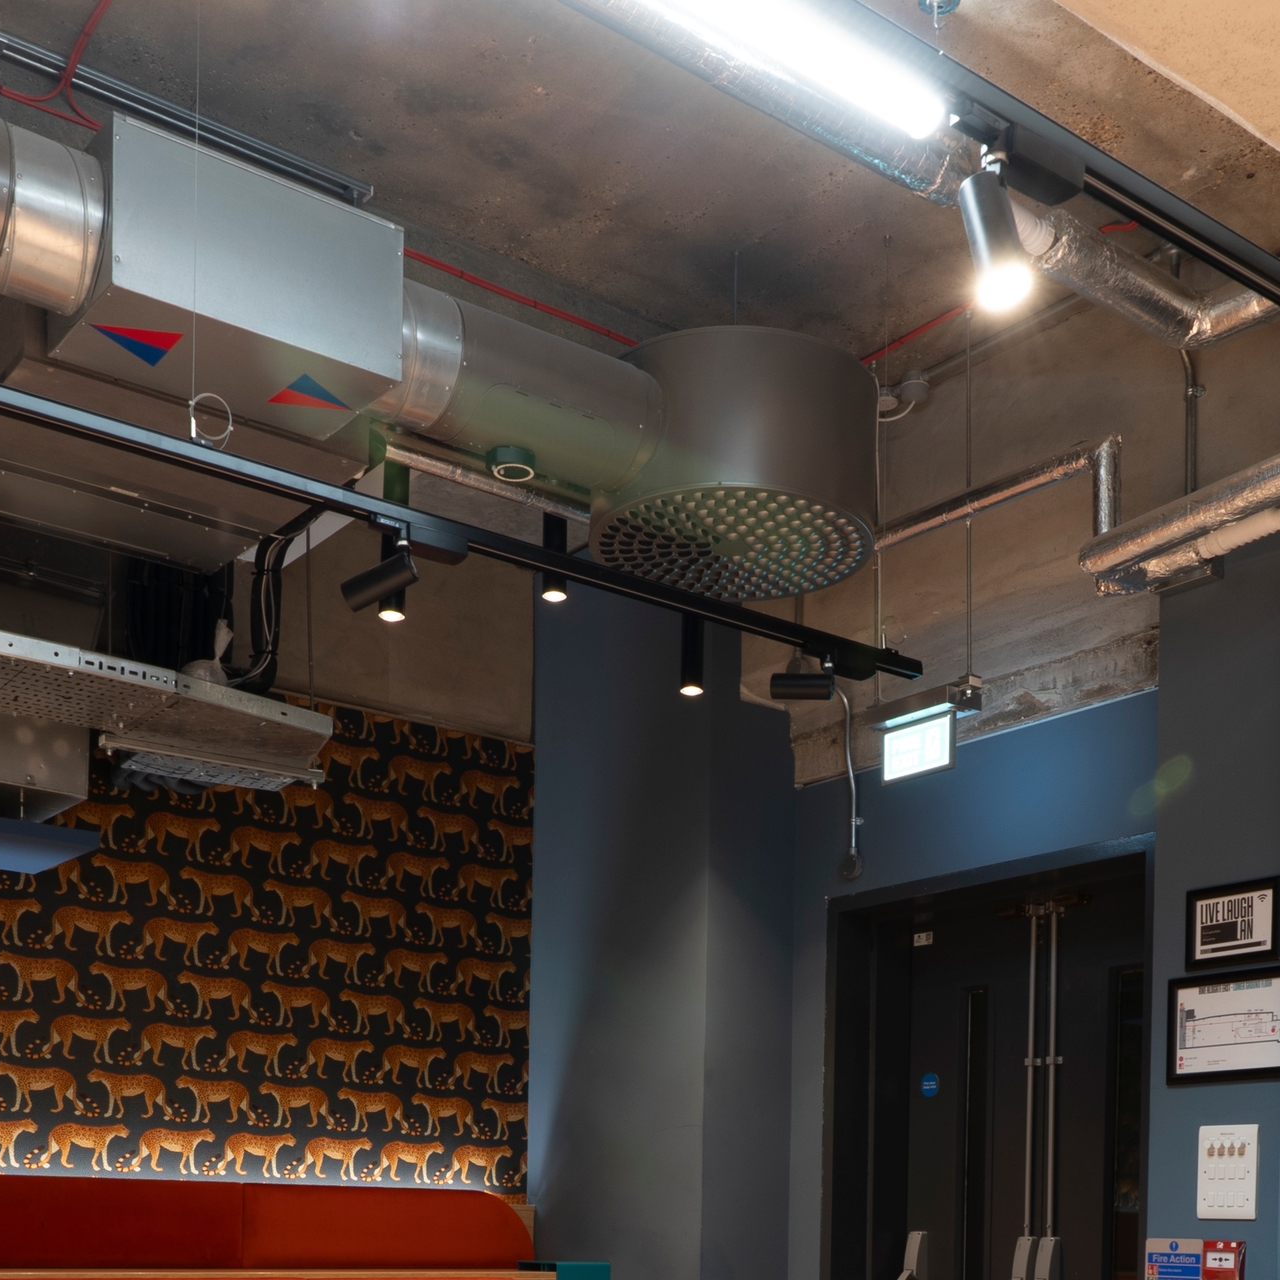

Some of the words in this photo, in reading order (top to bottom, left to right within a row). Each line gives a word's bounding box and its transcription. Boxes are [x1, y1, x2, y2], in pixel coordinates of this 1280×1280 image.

[1201, 902, 1220, 925] LIVE
[1222, 896, 1253, 921] LAUGH
[1152, 1254, 1167, 1263] Fire
[1169, 1255, 1196, 1264] Action
